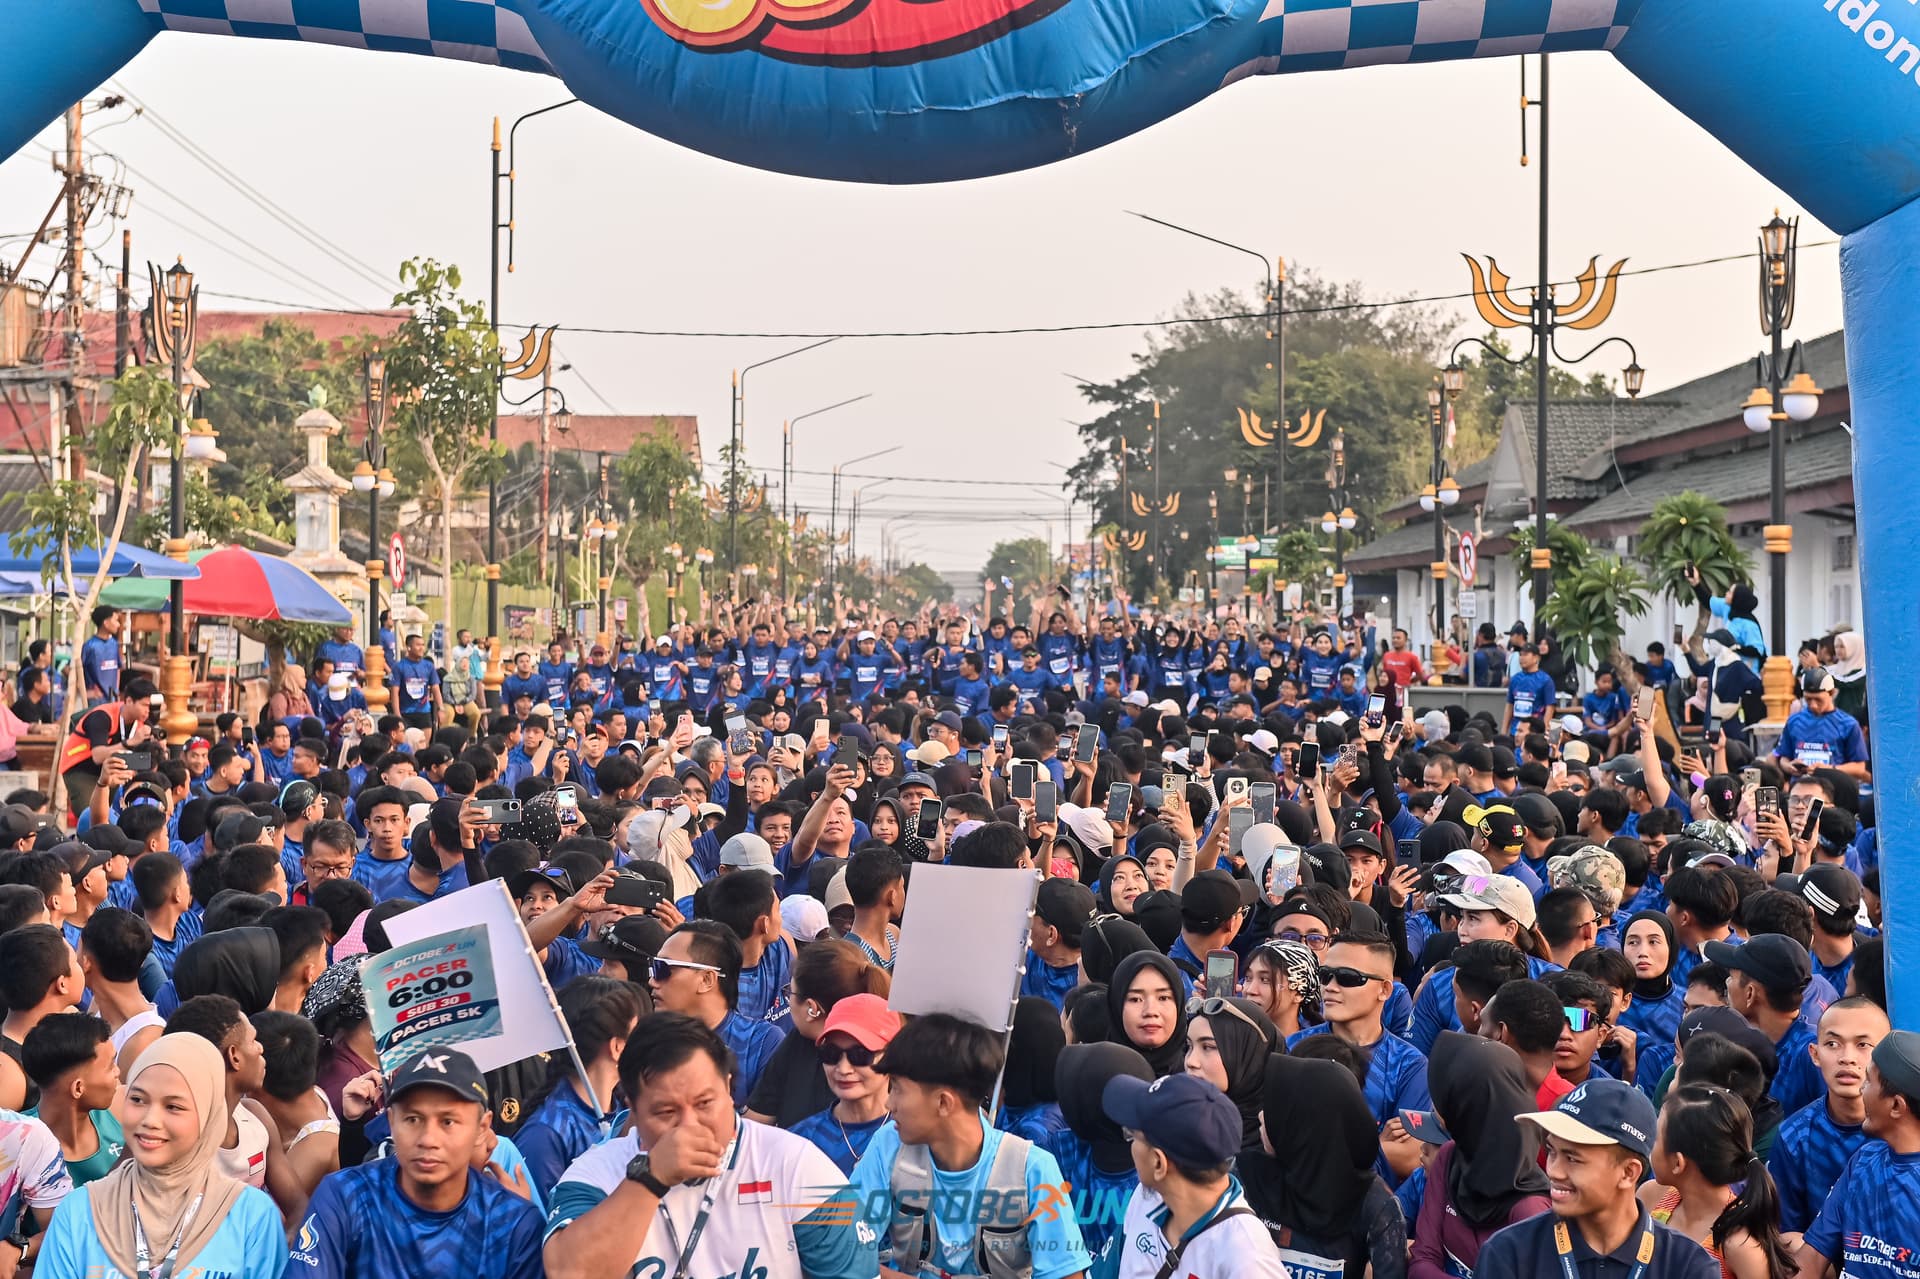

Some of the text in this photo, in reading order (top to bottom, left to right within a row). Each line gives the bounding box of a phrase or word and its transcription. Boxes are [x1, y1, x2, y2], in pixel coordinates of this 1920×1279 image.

[386, 958, 467, 992] PACER
[388, 970, 473, 1008] 6:00
[391, 1006, 482, 1043] PACER 5K
[406, 996, 460, 1019] SUB 30
[1621, 1122, 1647, 1142] amansa
